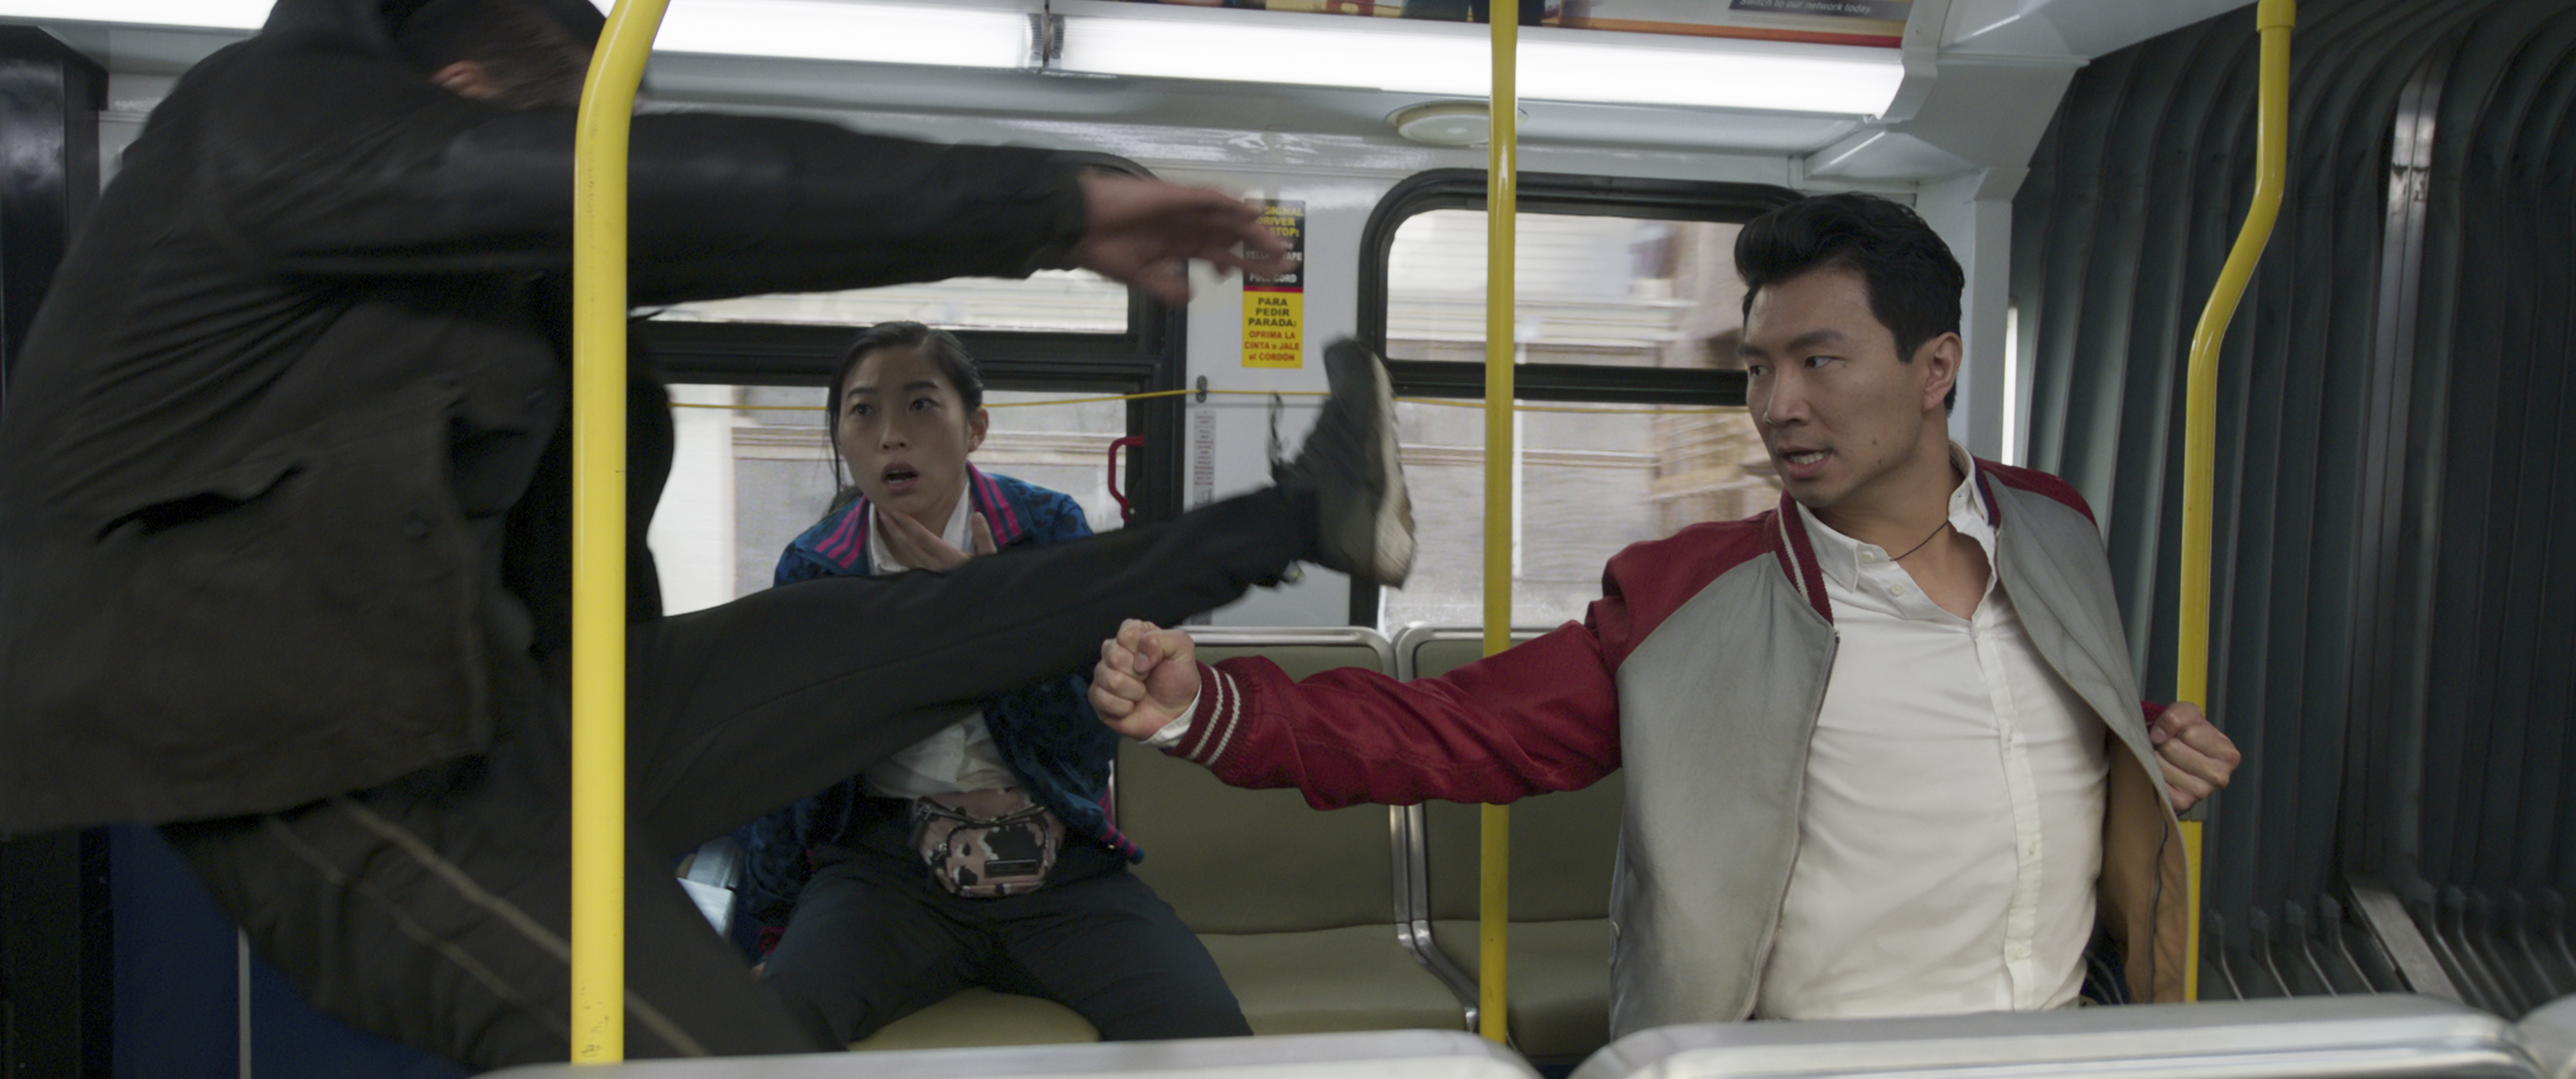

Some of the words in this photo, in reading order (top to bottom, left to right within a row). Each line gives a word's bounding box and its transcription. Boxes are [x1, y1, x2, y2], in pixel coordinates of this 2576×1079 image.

[1804, 2, 1842, 11] network
[1265, 206, 1303, 216] SIGNAL
[1274, 274, 1297, 283] CORD
[1258, 297, 1288, 306] PARA
[1256, 307, 1290, 317] PEDIR
[1248, 330, 1282, 339] OPRIMA
[1285, 331, 1296, 340] LA
[1279, 342, 1300, 351] JALE
